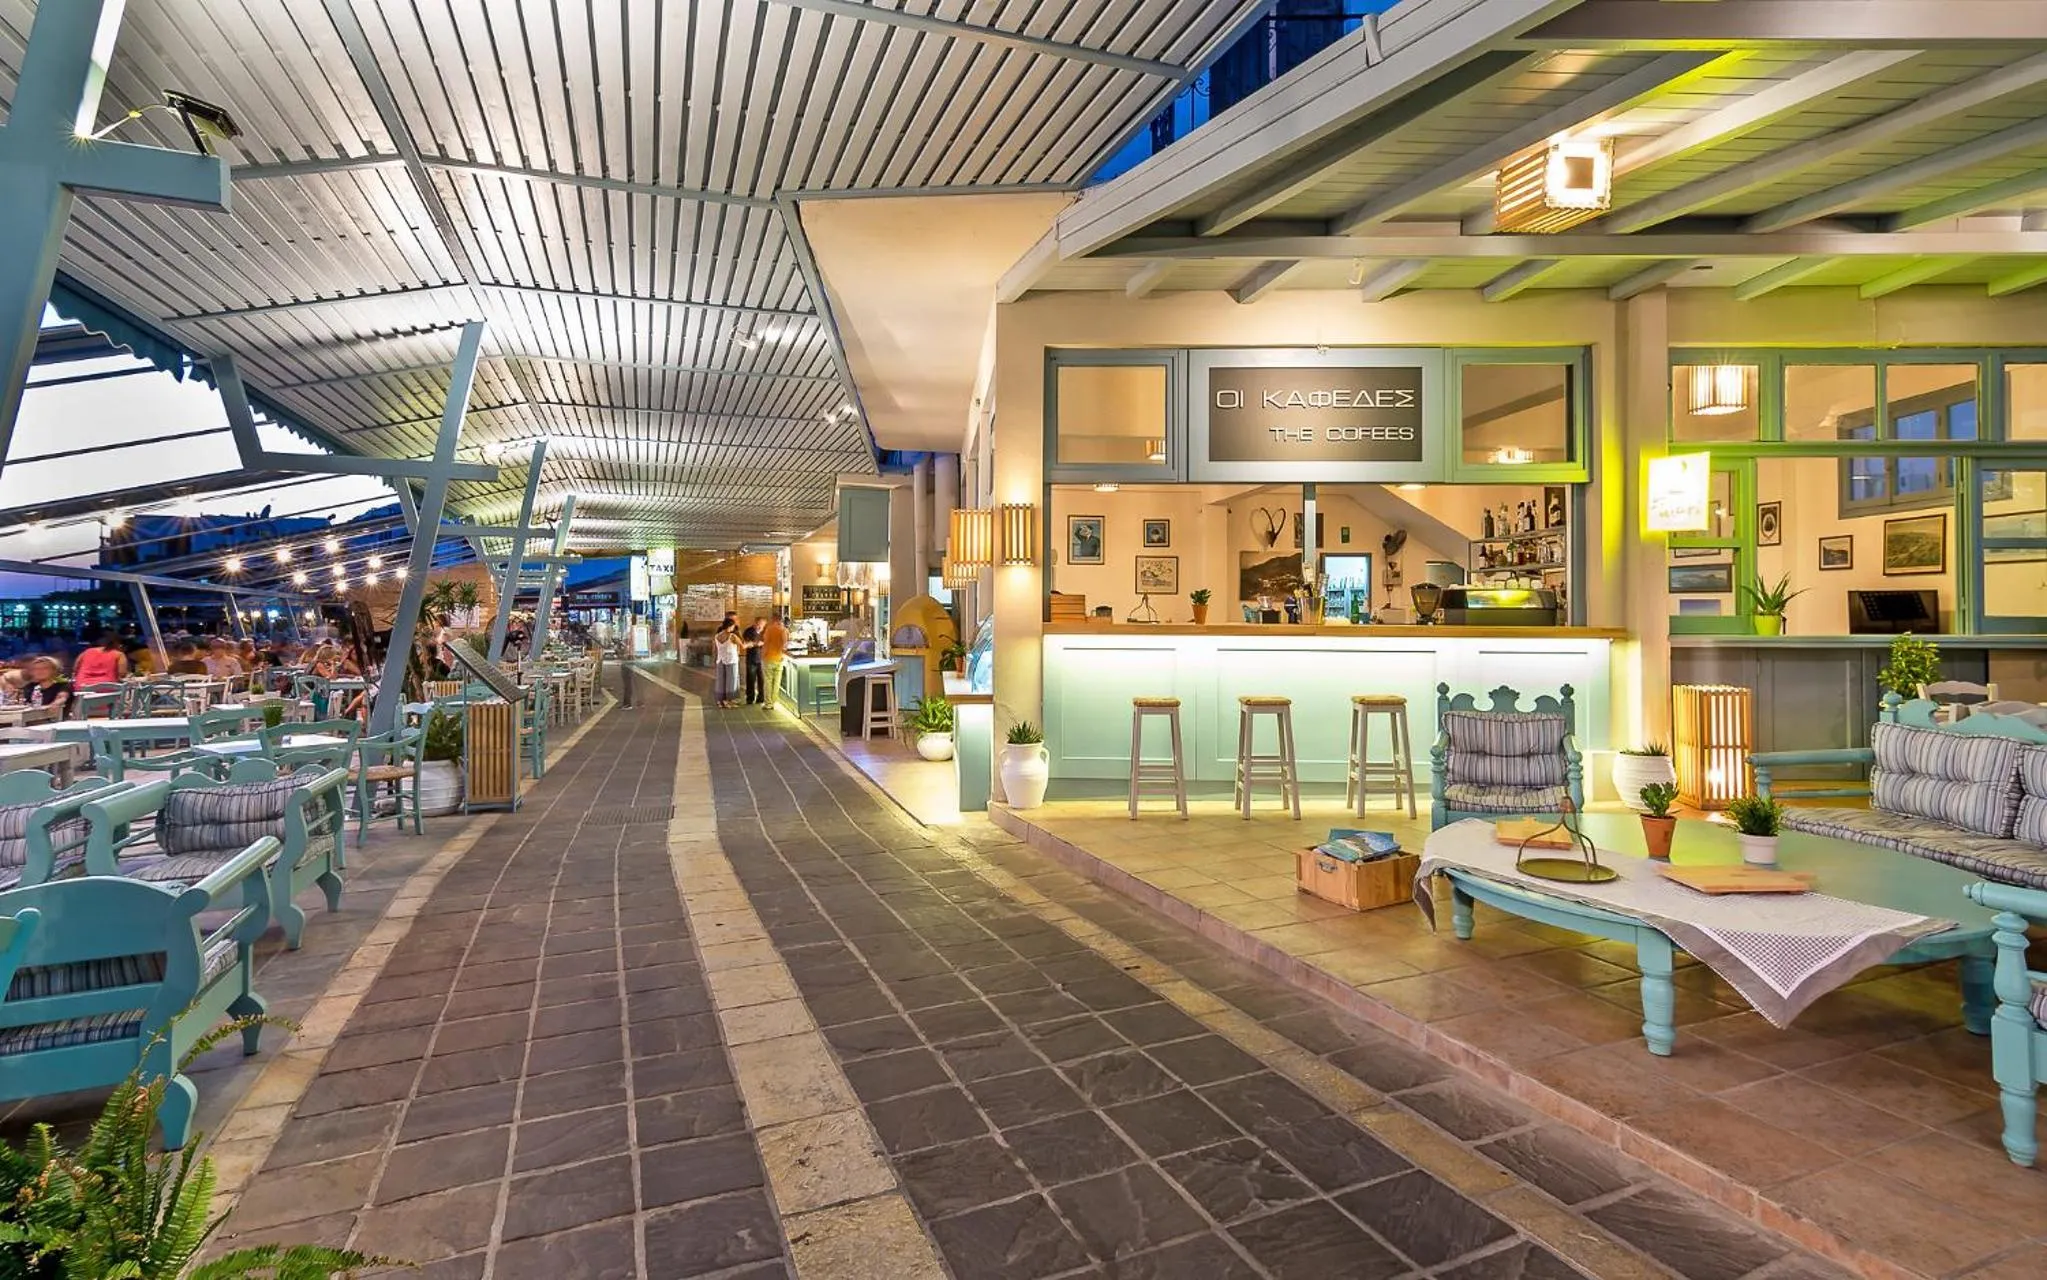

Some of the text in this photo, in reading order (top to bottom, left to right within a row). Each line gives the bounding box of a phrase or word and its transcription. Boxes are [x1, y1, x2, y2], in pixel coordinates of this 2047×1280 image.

[1216, 390, 1415, 409] ΟΙ ΚΑΦΕΔΕΣ
[1269, 427, 1415, 442] THE COFEES
[649, 564, 674, 573] TAXI
